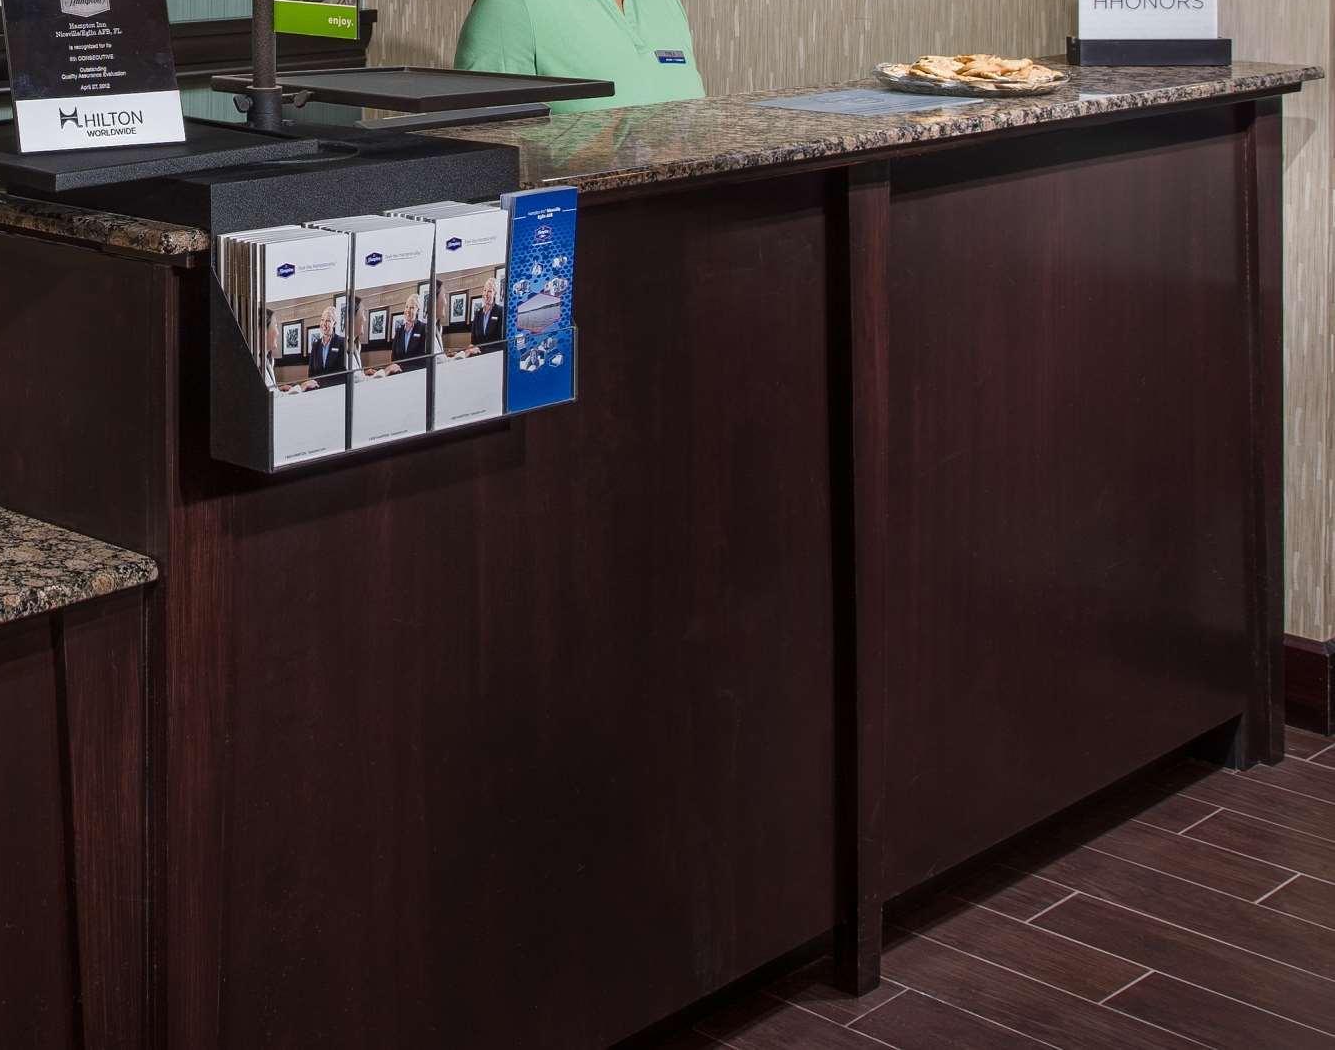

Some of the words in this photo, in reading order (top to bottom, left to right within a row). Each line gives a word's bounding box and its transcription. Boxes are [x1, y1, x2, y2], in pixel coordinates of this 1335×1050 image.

[328, 16, 354, 28] enjoy.
[84, 110, 144, 127] HILTON
[86, 127, 138, 138] WORLDWIDE
